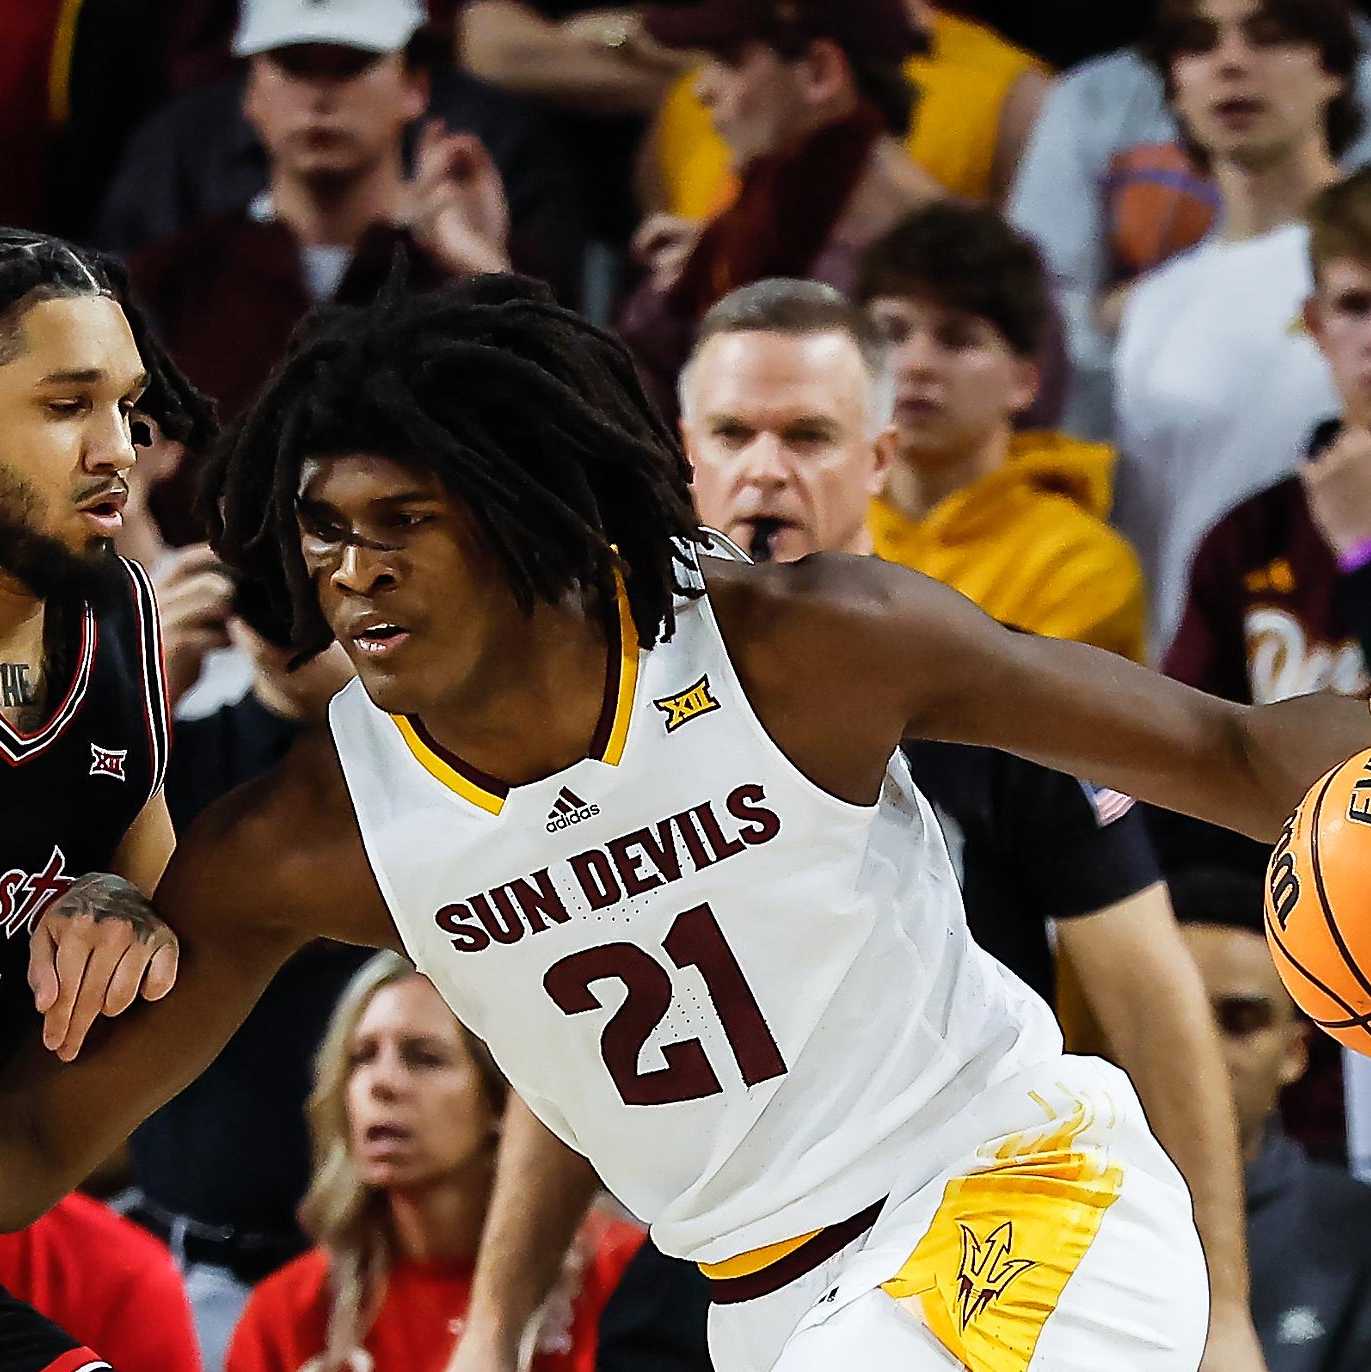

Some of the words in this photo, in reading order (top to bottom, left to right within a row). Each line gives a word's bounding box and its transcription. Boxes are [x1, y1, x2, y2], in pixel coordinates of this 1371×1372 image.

[434, 866, 573, 953] SUN
[565, 783, 781, 912] DEVILS
[546, 802, 600, 833] adidas
[542, 901, 789, 1107] 21
